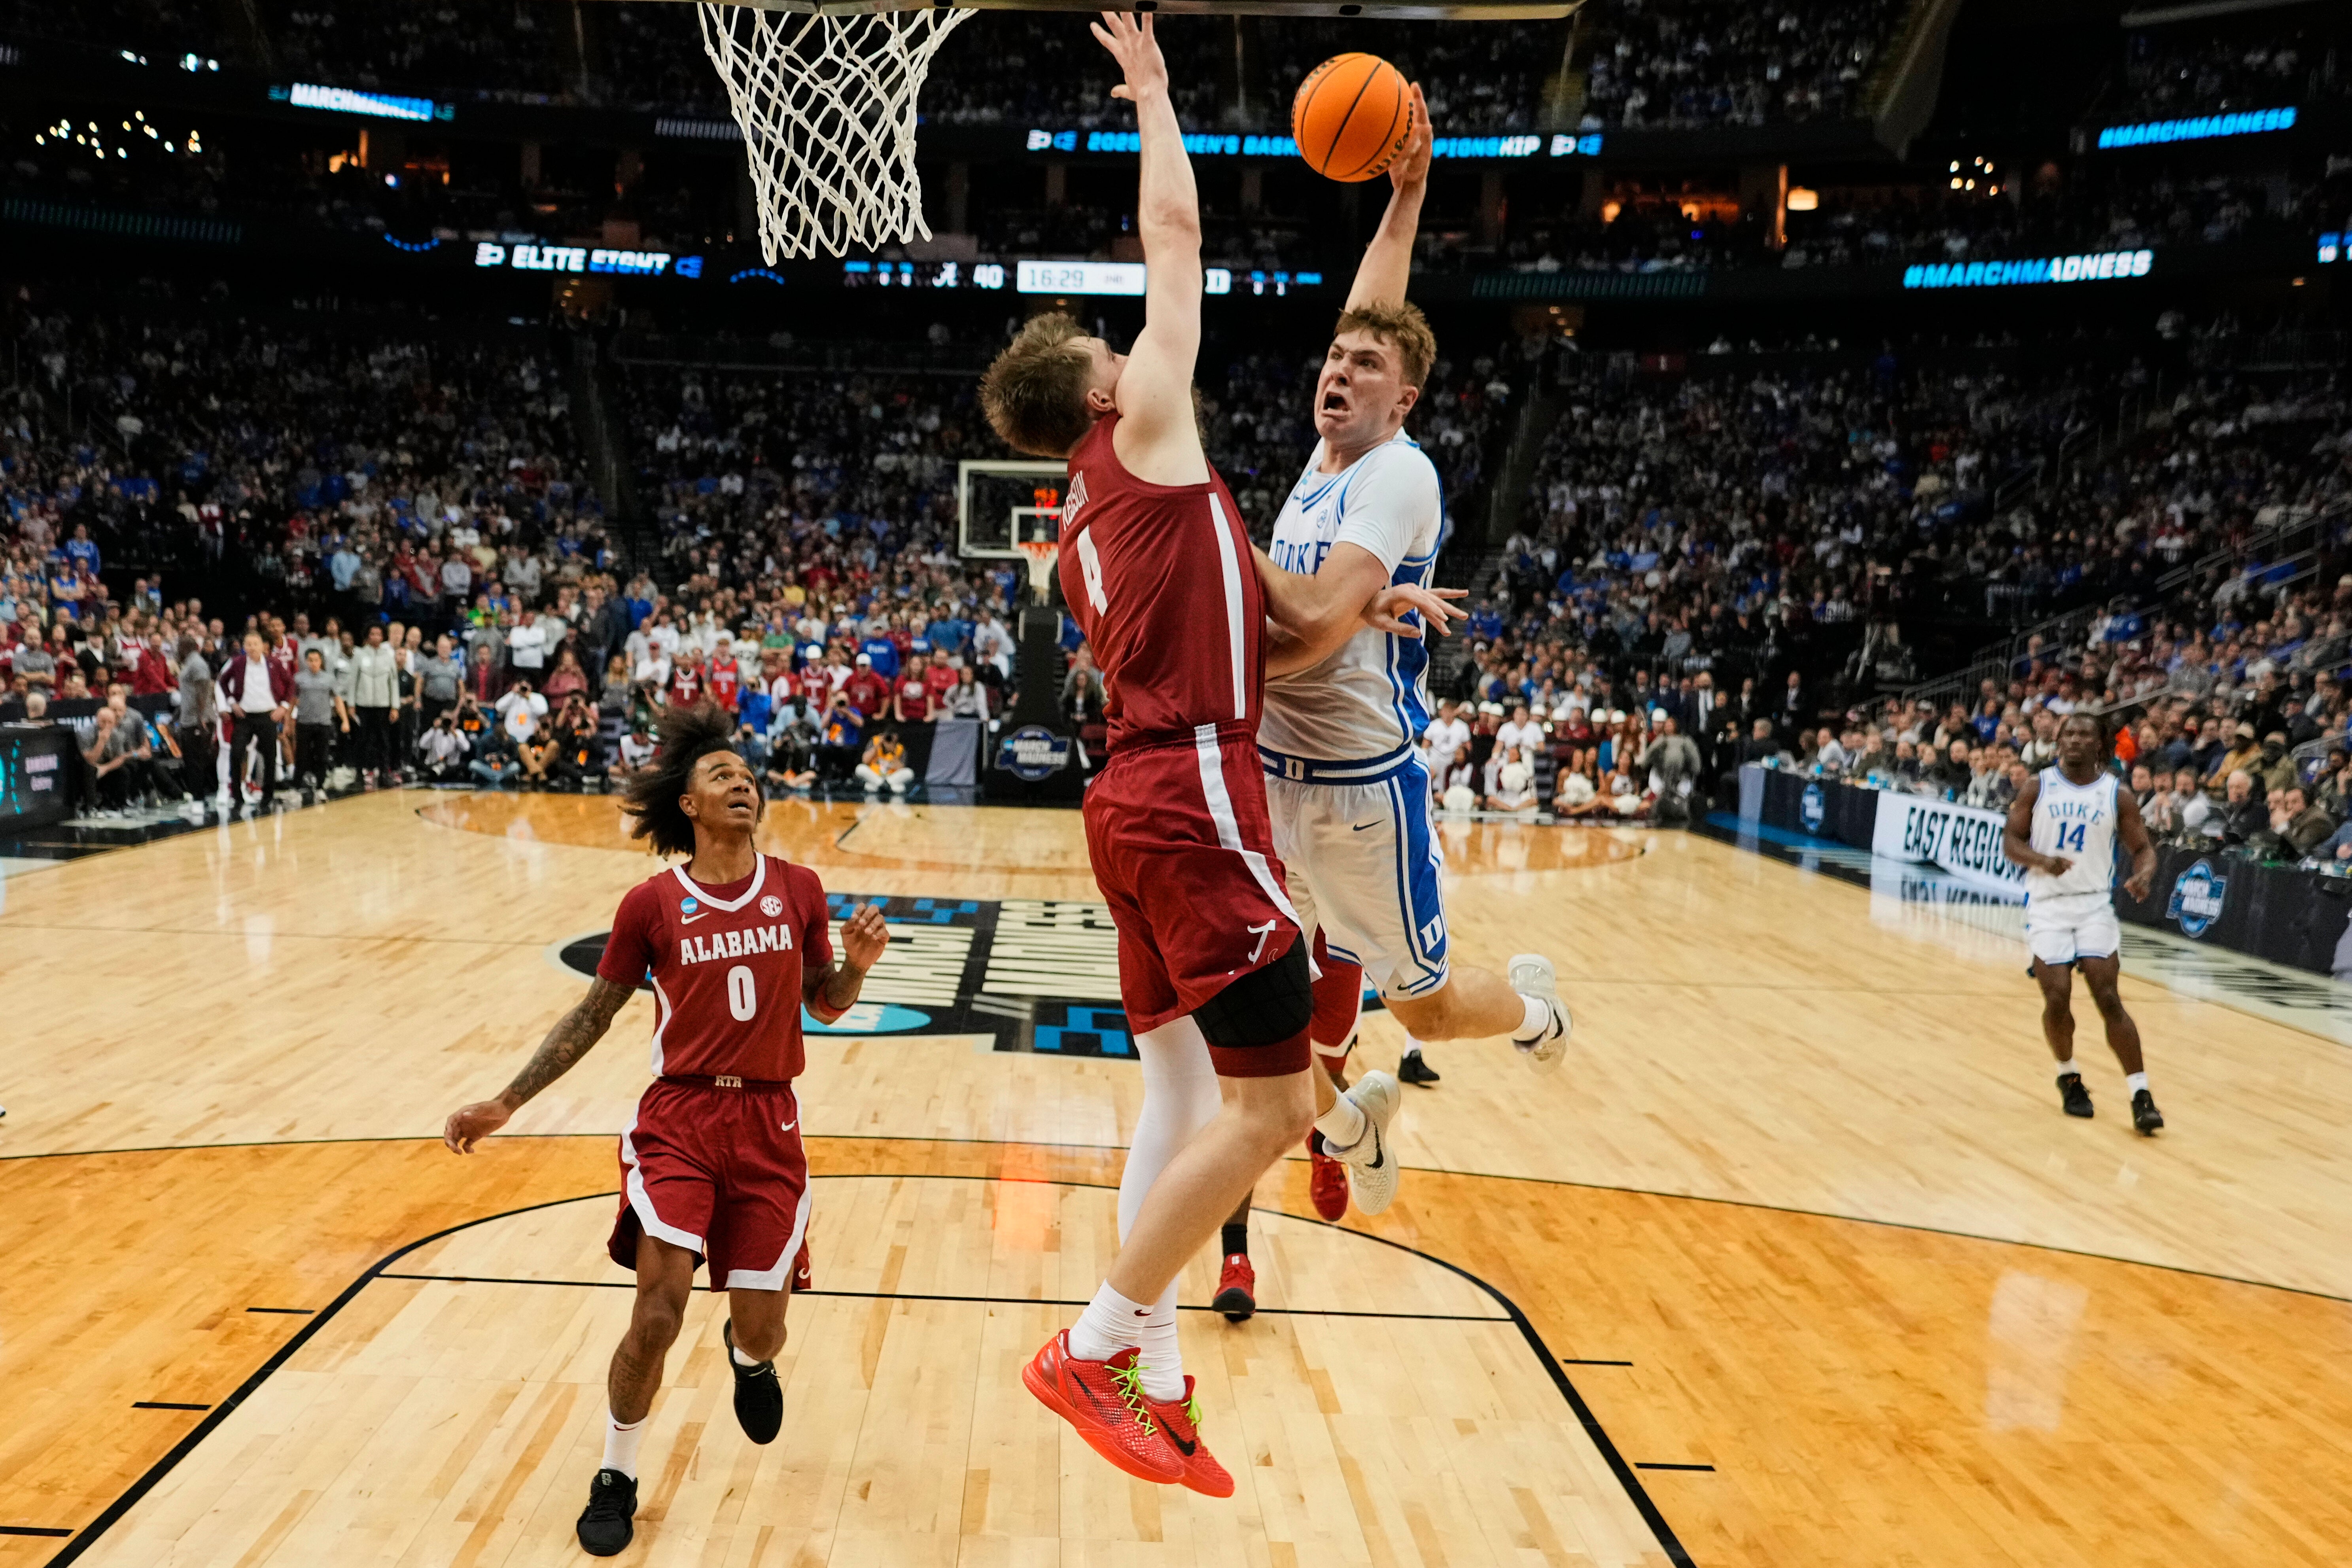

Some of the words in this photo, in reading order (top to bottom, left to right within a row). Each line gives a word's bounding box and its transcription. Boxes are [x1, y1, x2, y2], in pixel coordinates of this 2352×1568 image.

[2098, 106, 2297, 149] #MARCHMADNESS
[512, 244, 587, 272] ELITE
[1903, 249, 2153, 289] #MARCHMADNESS
[973, 264, 1004, 289] 40
[1030, 269, 1084, 287] 16:29
[1077, 524, 1108, 617] 4
[2048, 802, 2104, 826] DUKE
[1903, 807, 1950, 859] EAST
[1950, 816, 2017, 879] REGIO
[2056, 821, 2086, 852] 14
[761, 897, 781, 915] SEC
[680, 924, 793, 966] ALABAMA
[1420, 914, 1443, 954] D
[727, 965, 756, 1021] 0
[715, 1075, 742, 1088] RTR
